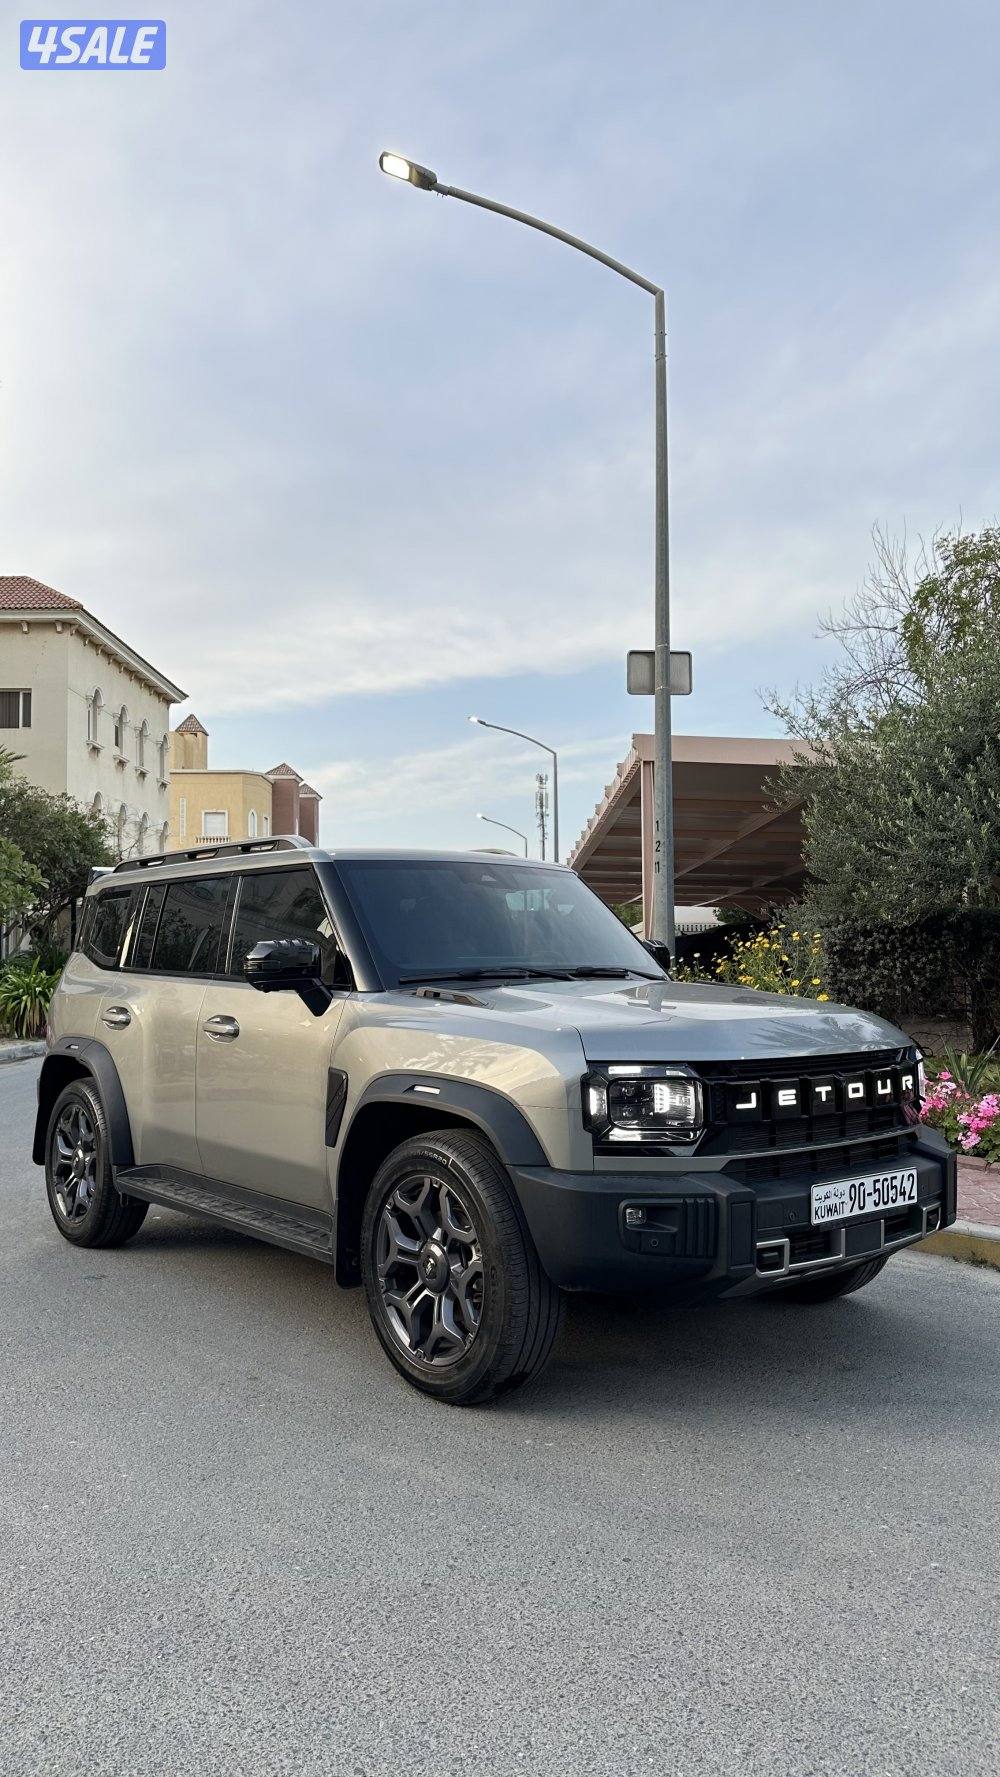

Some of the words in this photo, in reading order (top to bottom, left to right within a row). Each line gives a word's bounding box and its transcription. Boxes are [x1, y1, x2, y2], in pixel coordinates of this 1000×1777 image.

[655, 820, 660, 832] 1
[655, 840, 661, 852] 2
[735, 1074, 913, 1110] JETOUR
[849, 1173, 915, 1213] 90-50542
[814, 1201, 845, 1220] KUWAIT
